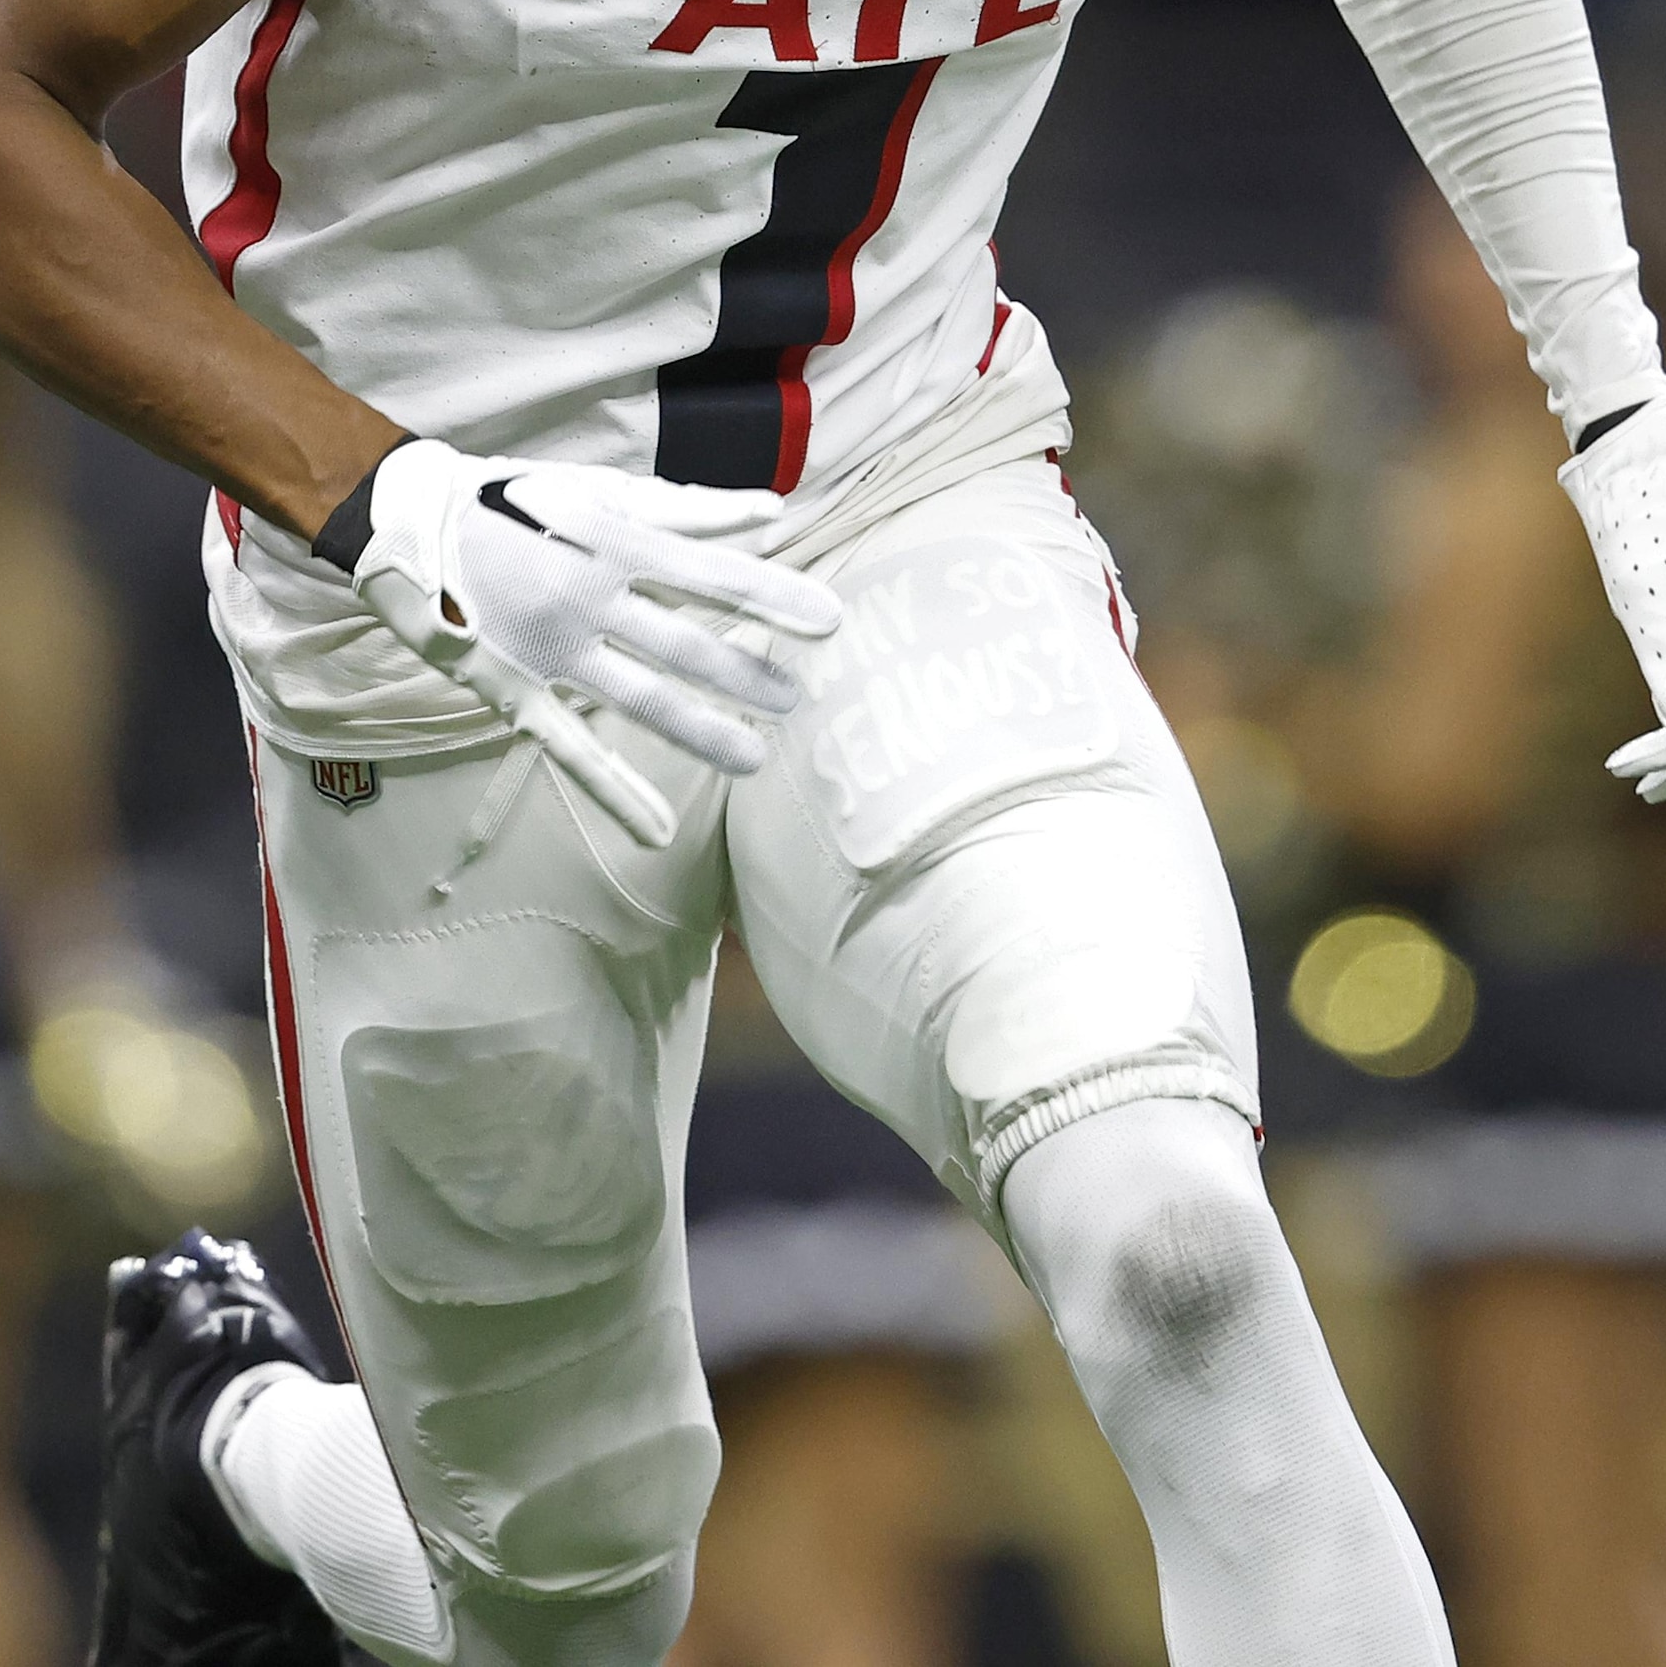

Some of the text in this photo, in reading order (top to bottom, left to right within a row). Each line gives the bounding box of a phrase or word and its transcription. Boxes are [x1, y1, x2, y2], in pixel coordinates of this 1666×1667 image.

[653, 54, 951, 497] 1
[943, 556, 1041, 618] SO
[317, 760, 370, 796] NFL
